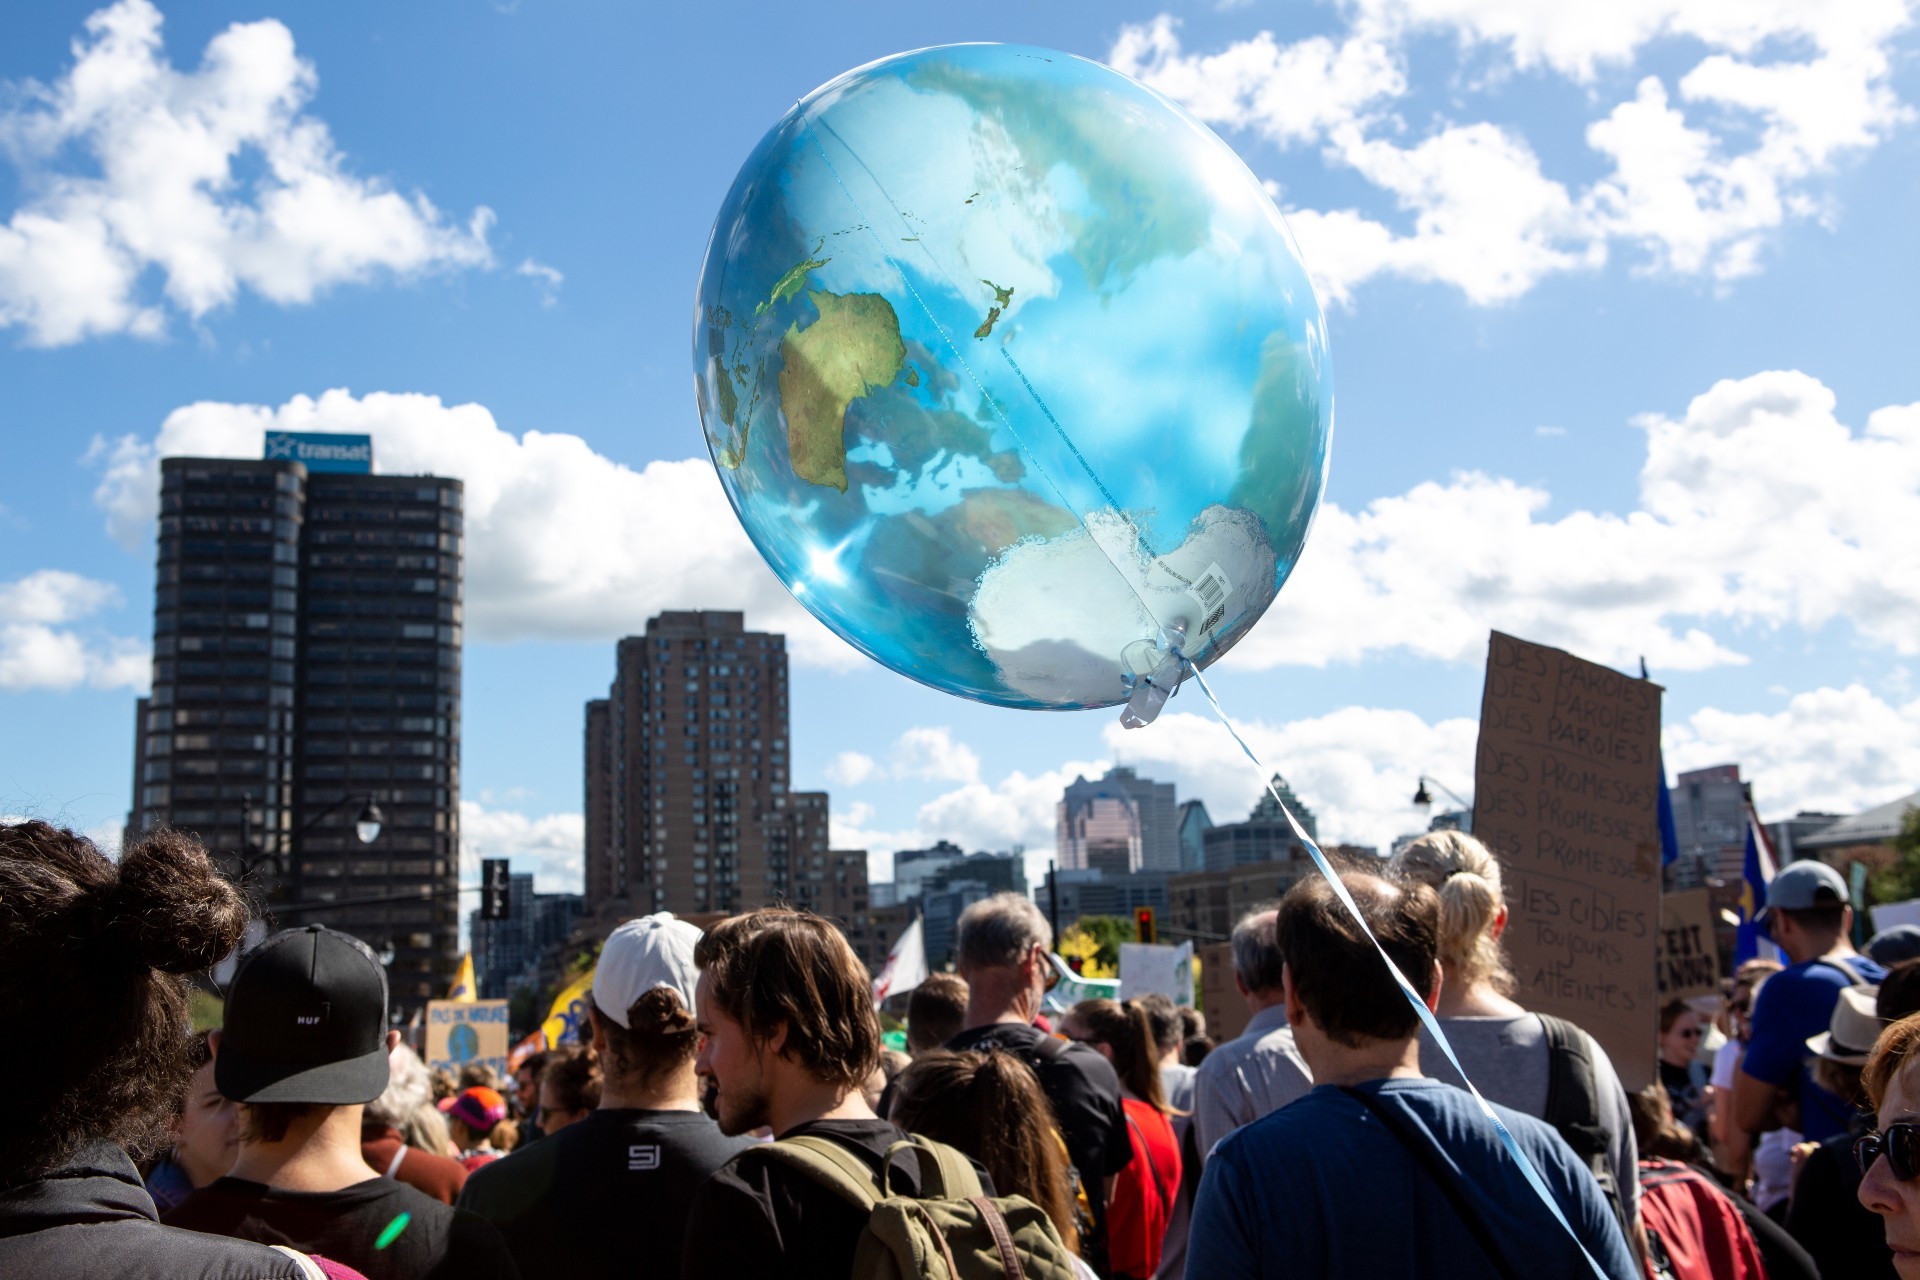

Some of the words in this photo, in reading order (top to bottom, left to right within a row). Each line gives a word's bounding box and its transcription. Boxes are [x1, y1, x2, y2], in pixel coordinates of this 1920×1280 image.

[1007, 357, 1016, 368] USED
[1026, 383, 1041, 403] BALLOON
[1039, 402, 1055, 423] CONFORM
[1057, 428, 1078, 455] GOVERNMENT
[1092, 476, 1102, 487] THAT
[296, 440, 372, 461] transat
[1495, 639, 1547, 677] DES
[1490, 670, 1542, 704] DES
[1486, 701, 1533, 735] DES
[1481, 741, 1529, 783] DES
[1479, 783, 1528, 818] DES
[297, 1016, 320, 1025] HUF
